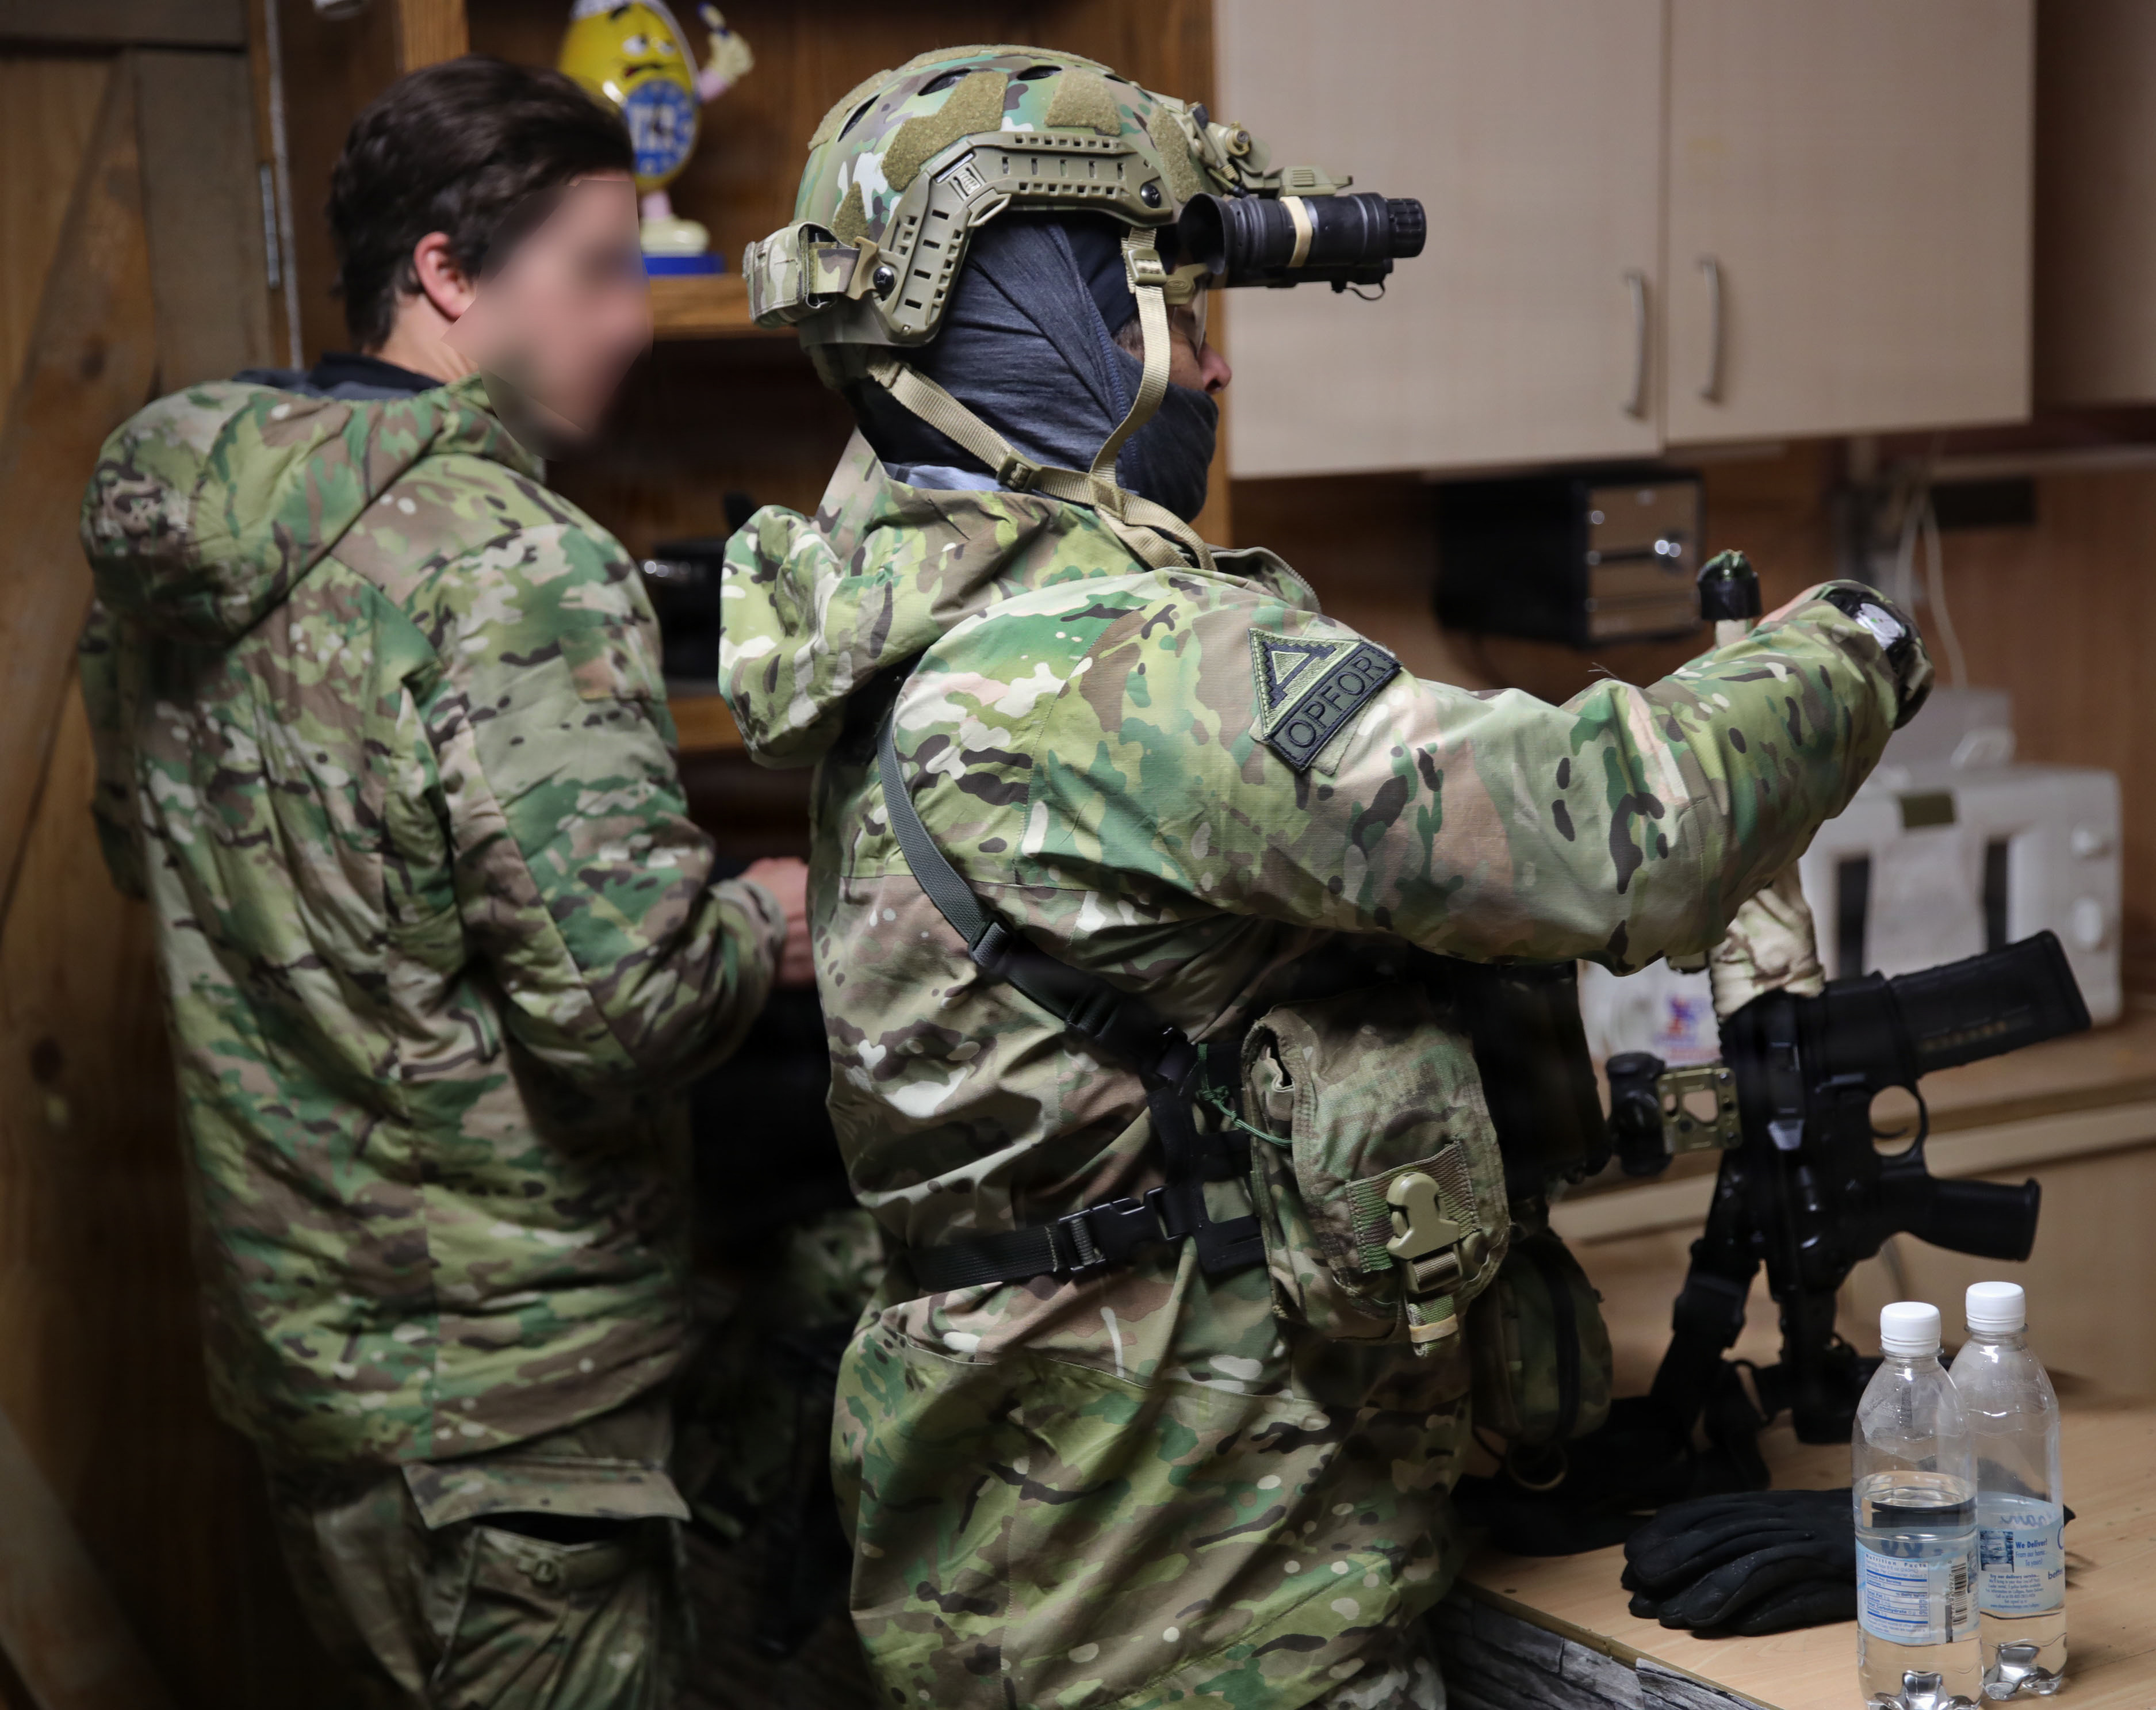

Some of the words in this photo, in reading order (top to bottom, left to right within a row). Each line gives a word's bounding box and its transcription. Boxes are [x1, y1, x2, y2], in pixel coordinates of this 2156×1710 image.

[1286, 656, 1387, 749] OPFOR
[2027, 1538, 2047, 1548] Deliver!
[1866, 1553, 1896, 1566] Nutrition
[1877, 1604, 1907, 1614] Carbohydrate
